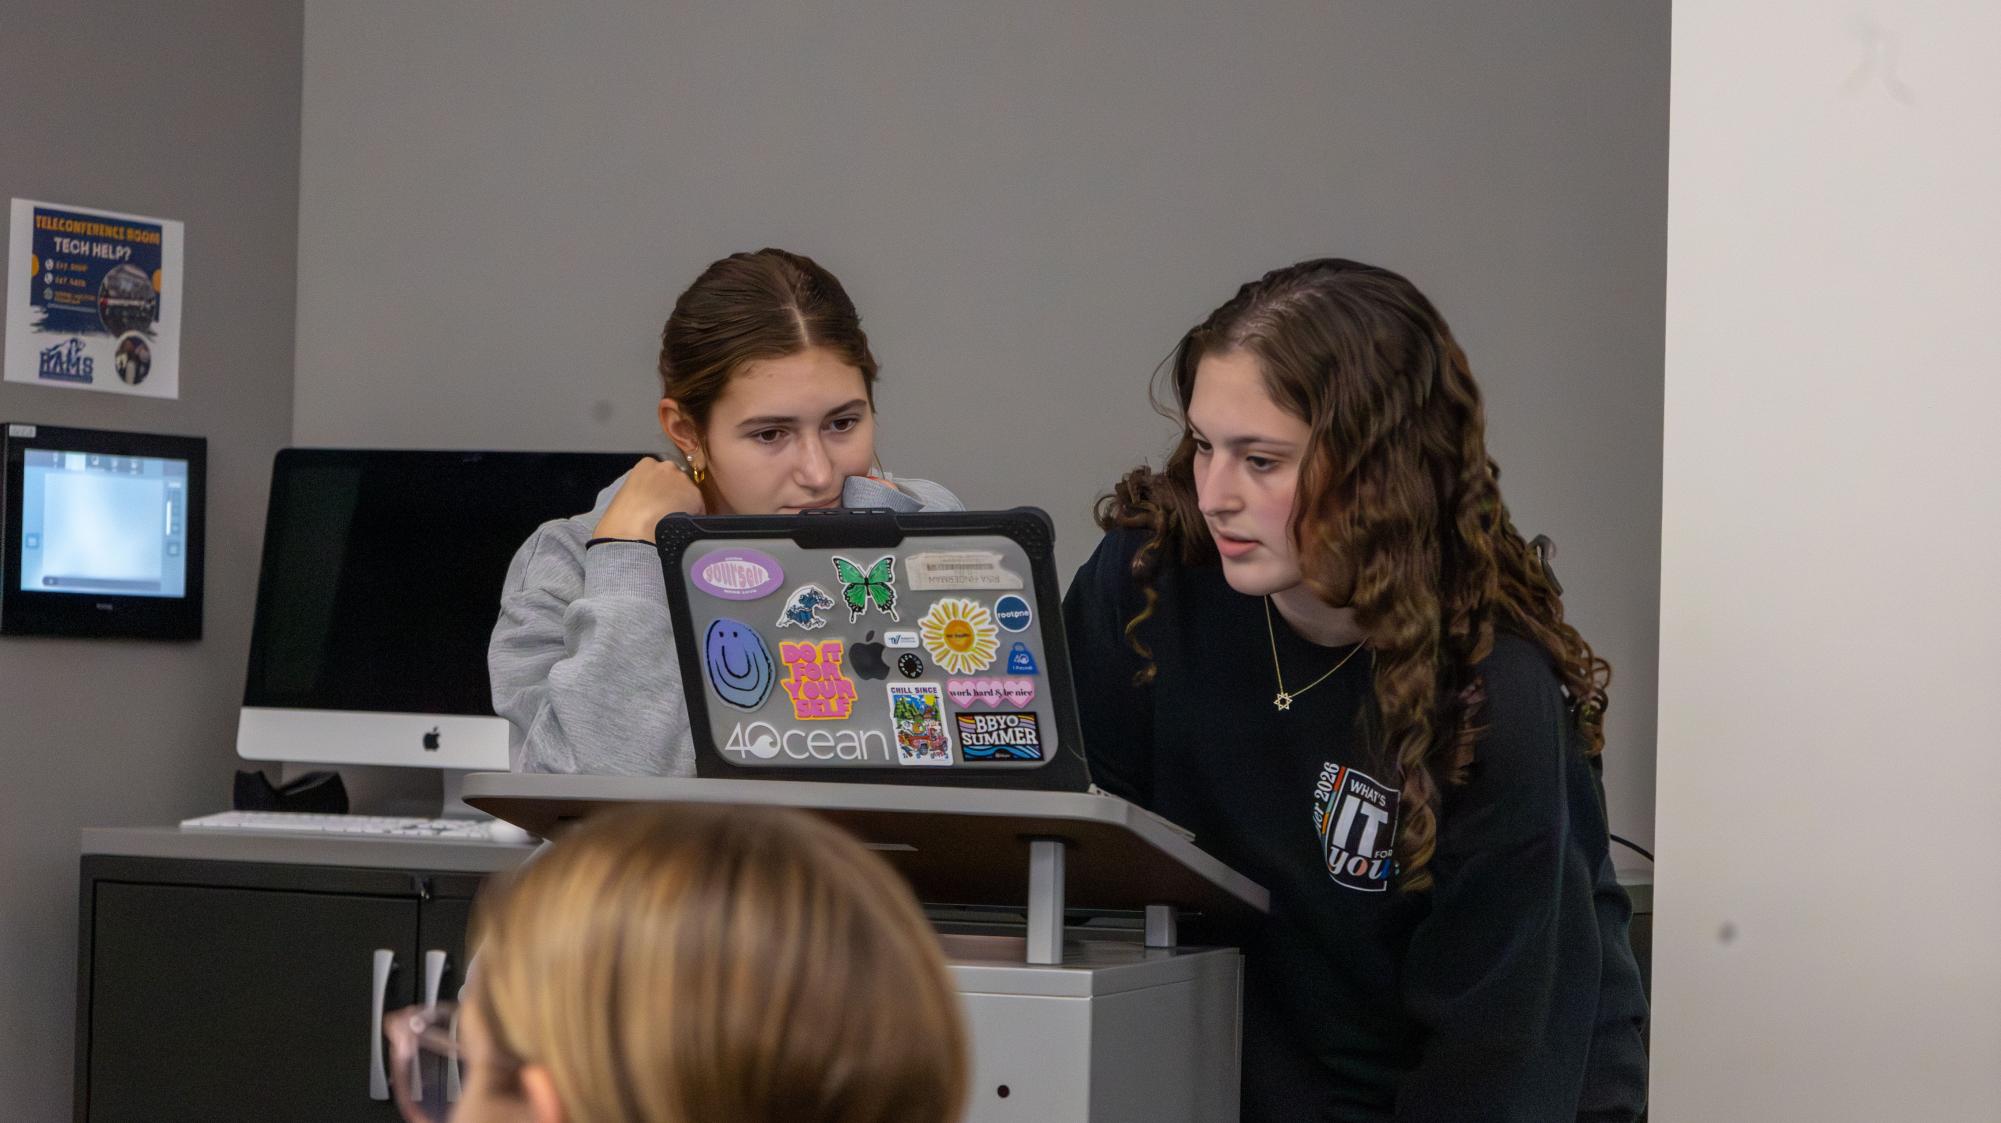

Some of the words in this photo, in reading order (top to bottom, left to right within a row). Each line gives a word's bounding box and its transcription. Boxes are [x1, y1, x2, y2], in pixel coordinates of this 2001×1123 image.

[53, 237, 89, 256] TECH
[92, 242, 131, 261] HELP?
[782, 644, 816, 663] DO
[822, 643, 841, 662] IT
[793, 662, 841, 681] FOR
[783, 680, 856, 700] YOUR
[950, 689, 972, 697] work
[974, 689, 994, 697] hard
[995, 689, 1001, 697] &
[1003, 688, 1013, 697] be
[1015, 688, 1033, 697] nice
[796, 699, 849, 717] SELF
[974, 715, 1019, 733] BBYO
[962, 728, 1039, 746] SUMMER
[1314, 761, 1340, 802] 2026
[1350, 779, 1386, 807] WHAT'S
[1332, 794, 1389, 858] IT
[1328, 846, 1392, 880] you
